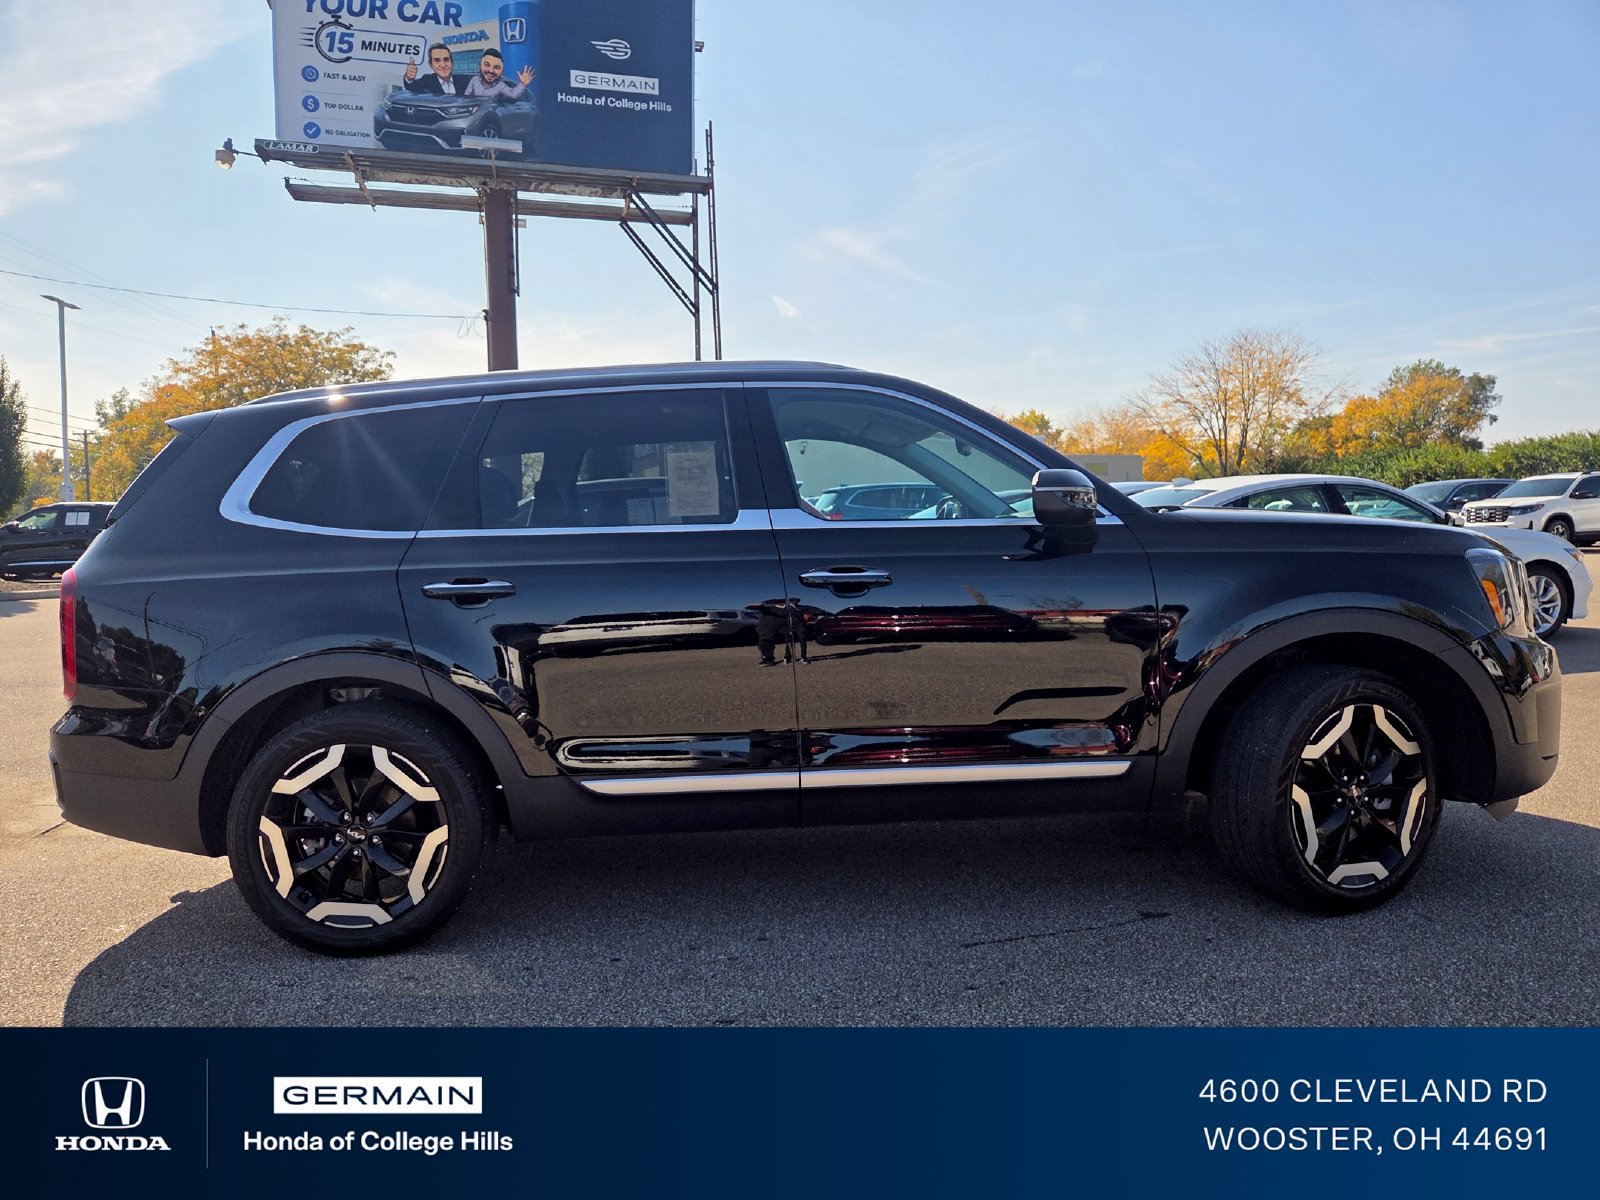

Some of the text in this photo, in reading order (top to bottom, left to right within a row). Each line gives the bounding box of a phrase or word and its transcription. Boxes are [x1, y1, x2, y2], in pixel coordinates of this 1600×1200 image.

[397, 0, 463, 28] CAR
[325, 31, 421, 56] 15 MINUTES
[442, 29, 490, 46] HONDA
[323, 72, 340, 80] FAST
[574, 74, 656, 92] GERMAIN
[338, 103, 364, 111] DOLLAR
[557, 92, 673, 113] Honda of College Hills
[270, 142, 314, 152] LAMAR
